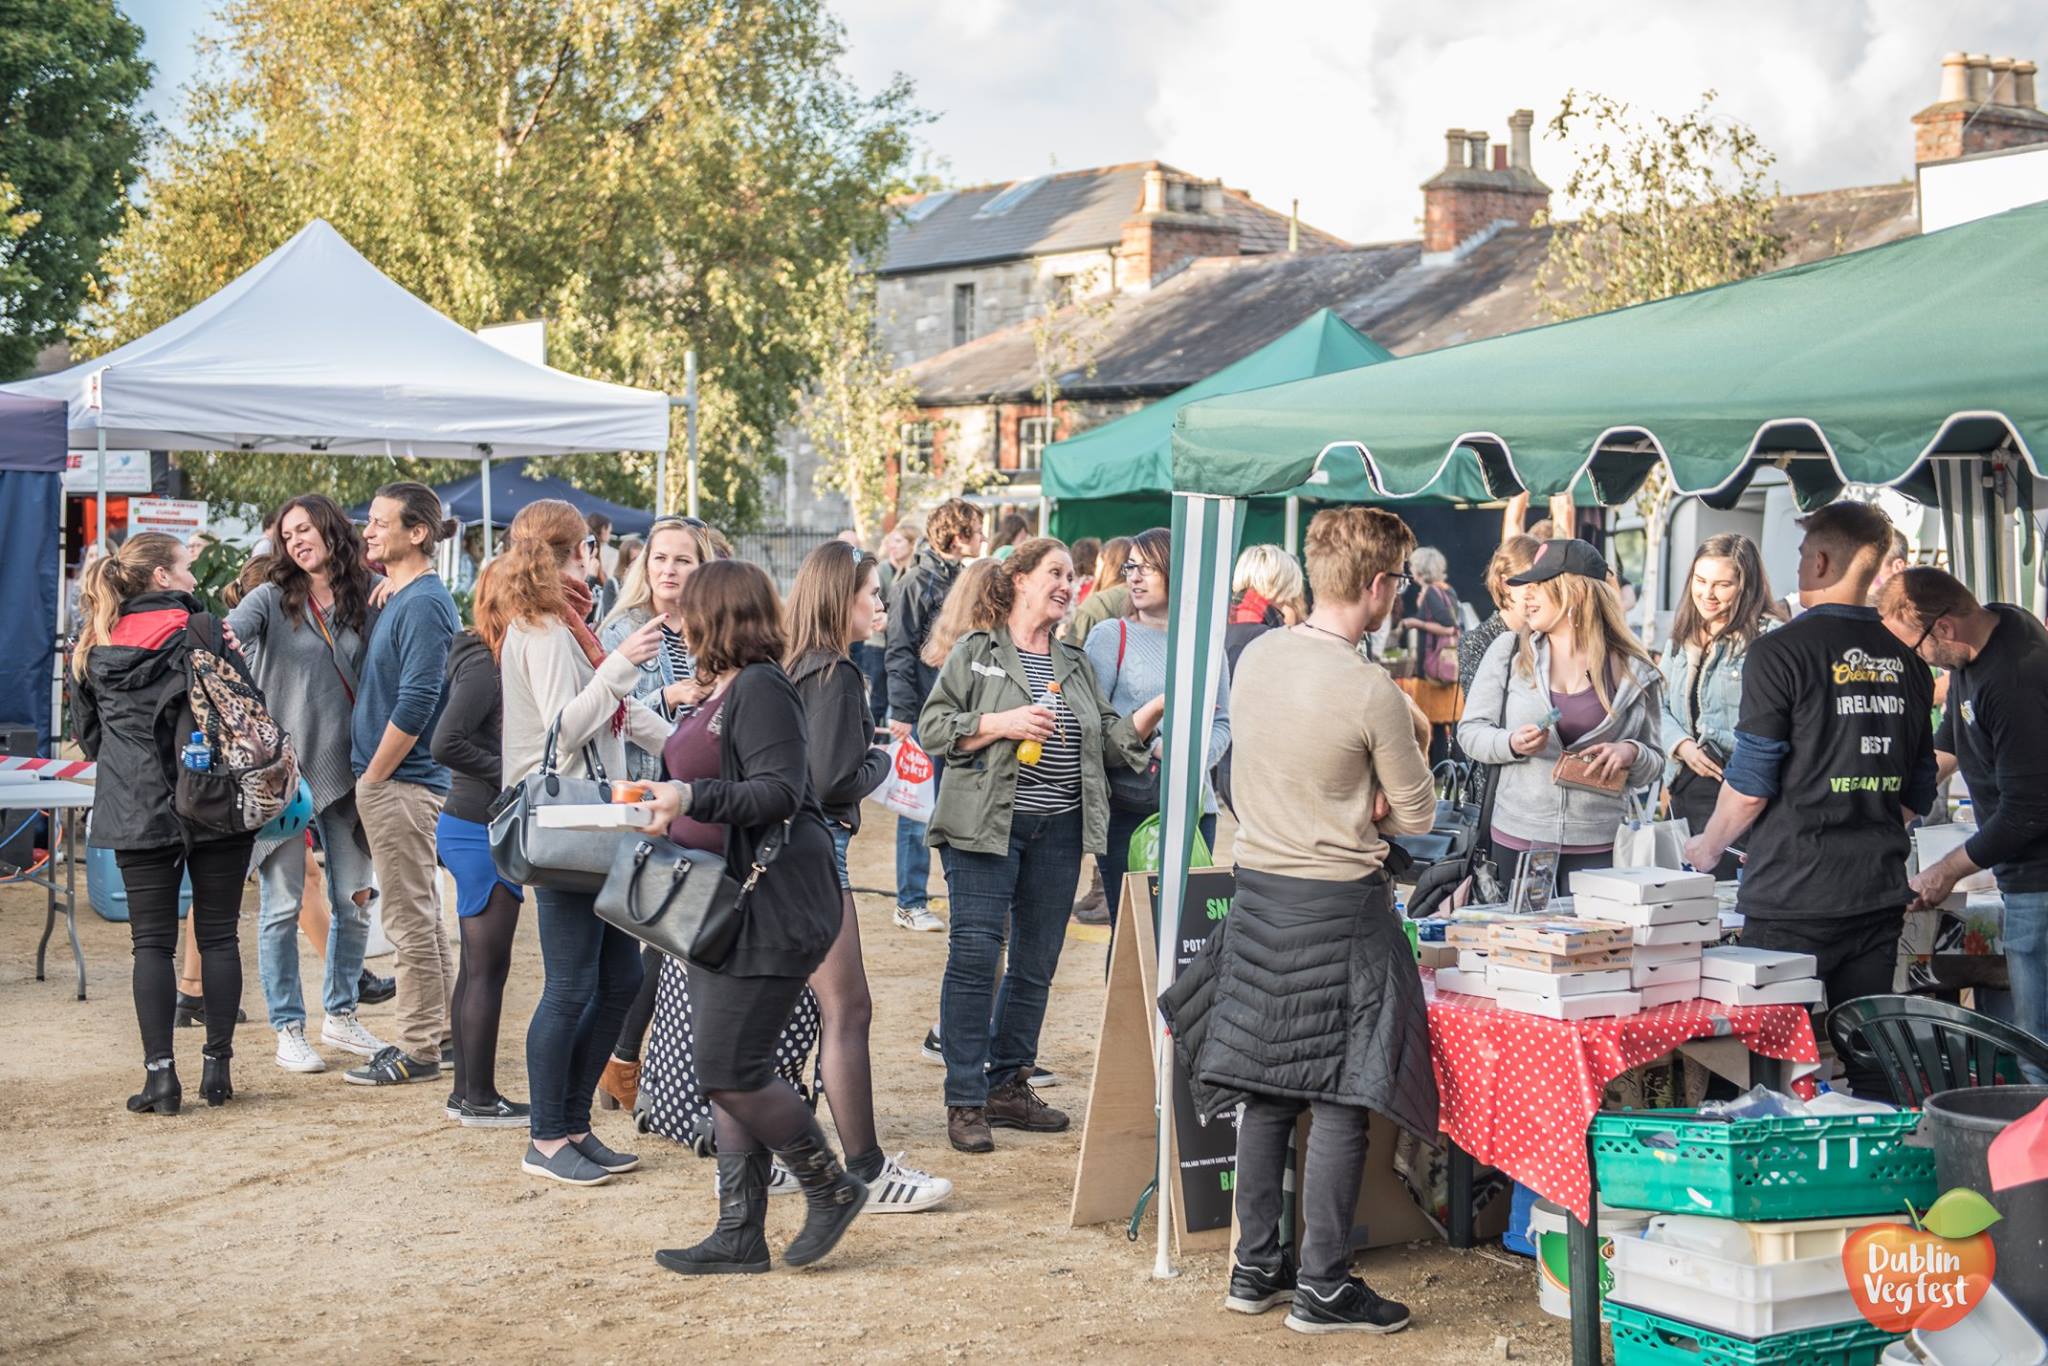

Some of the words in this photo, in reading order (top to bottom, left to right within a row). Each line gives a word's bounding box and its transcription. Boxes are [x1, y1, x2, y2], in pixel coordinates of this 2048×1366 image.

[1836, 695, 1905, 715] IRELANDS
[1861, 736, 1892, 754] BEST
[1830, 776, 1880, 793] VEGAN
[1206, 898, 1233, 920] SN
